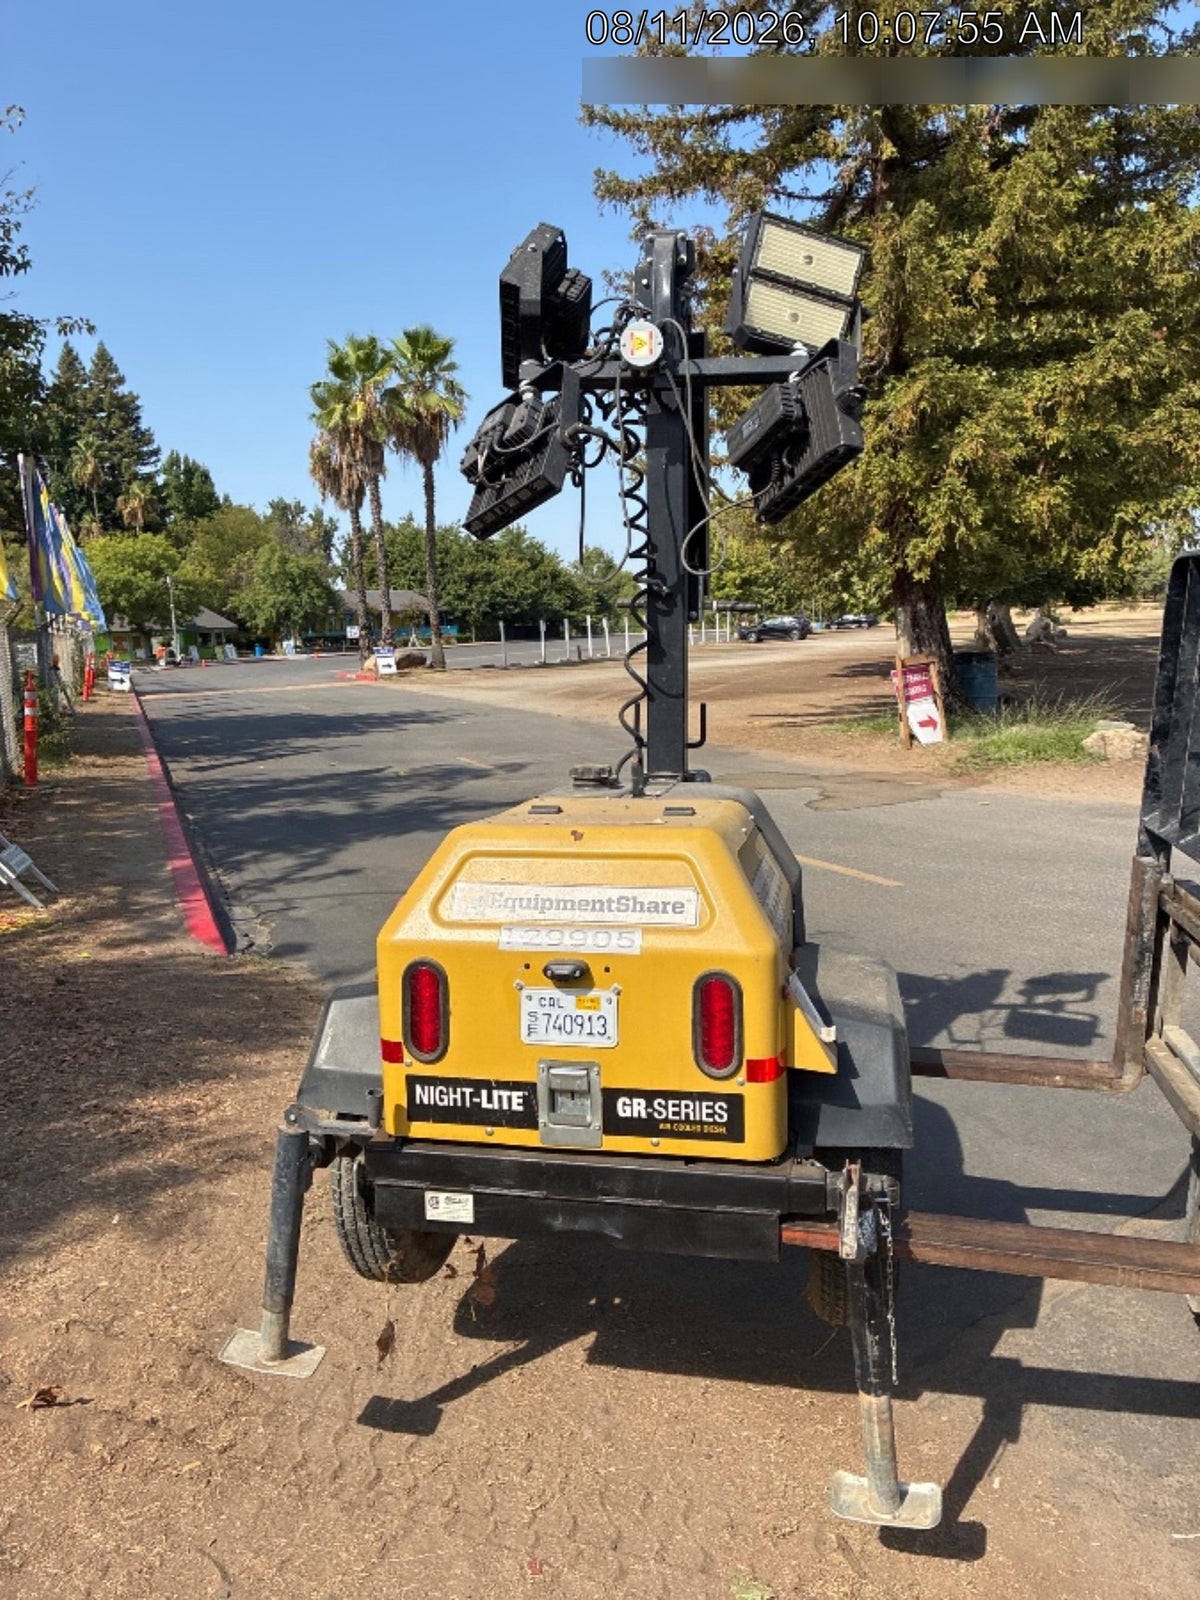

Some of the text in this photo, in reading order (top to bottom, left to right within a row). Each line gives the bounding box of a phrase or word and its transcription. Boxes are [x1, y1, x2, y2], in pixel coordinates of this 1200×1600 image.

[488, 892, 686, 915] EquipmentShare
[539, 996, 565, 1009] CAL
[541, 1012, 607, 1037] 740913
[414, 1084, 525, 1112] NIGHT-LITE
[616, 1096, 728, 1123] GR-SERIES
